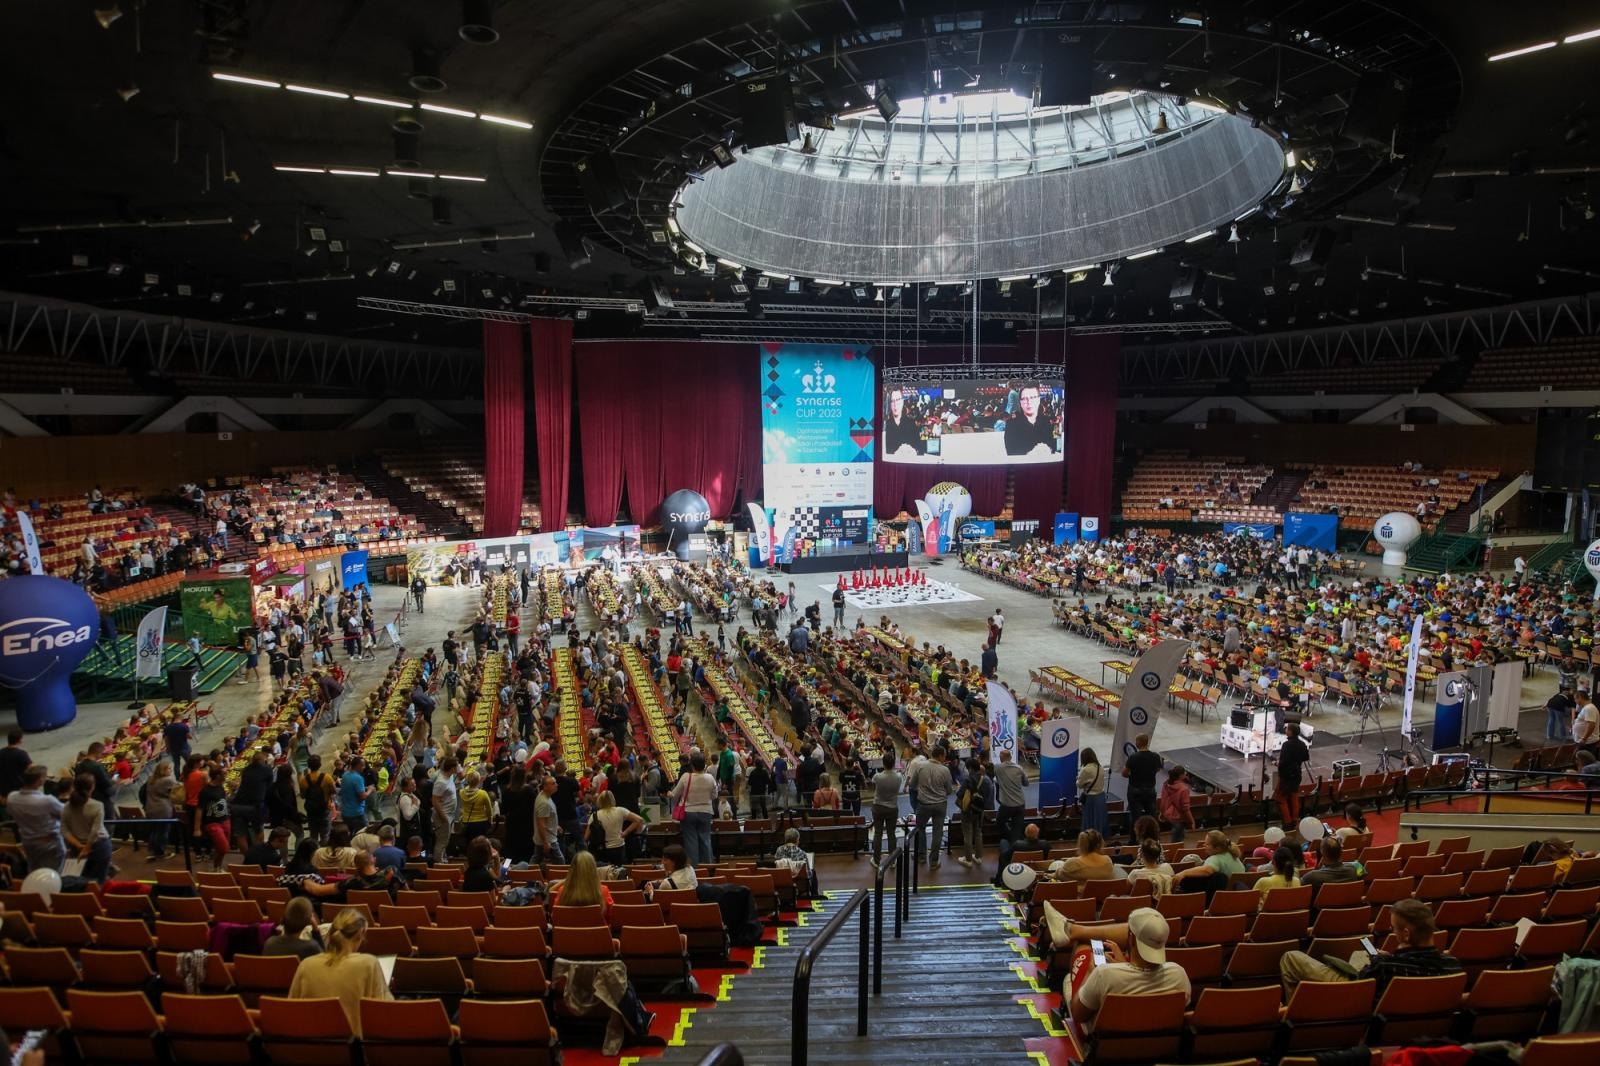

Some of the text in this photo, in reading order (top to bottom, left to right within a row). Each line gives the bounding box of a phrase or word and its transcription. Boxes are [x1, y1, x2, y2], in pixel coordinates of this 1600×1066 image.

[796, 408, 842, 418] CUP 2023
[963, 526, 986, 534] Enea
[3, 625, 91, 656] Enea
